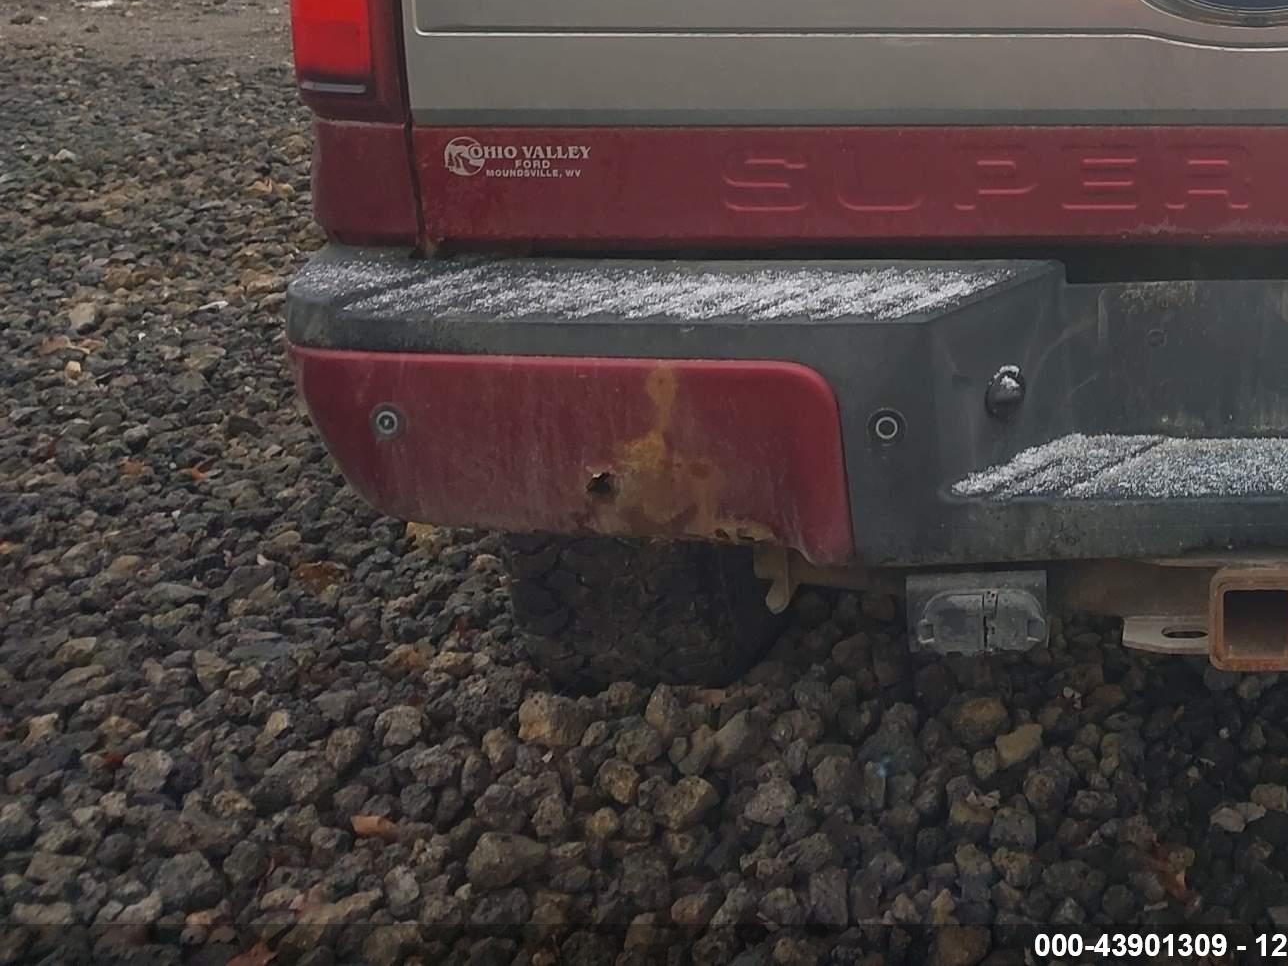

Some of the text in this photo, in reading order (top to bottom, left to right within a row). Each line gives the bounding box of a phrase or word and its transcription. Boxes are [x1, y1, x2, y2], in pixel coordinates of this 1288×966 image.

[469, 145, 592, 159] OHIO VALLEY
[515, 160, 551, 169] FORD
[486, 169, 582, 178] MOUNDSVILLE, WV
[721, 144, 1250, 211] SUPER
